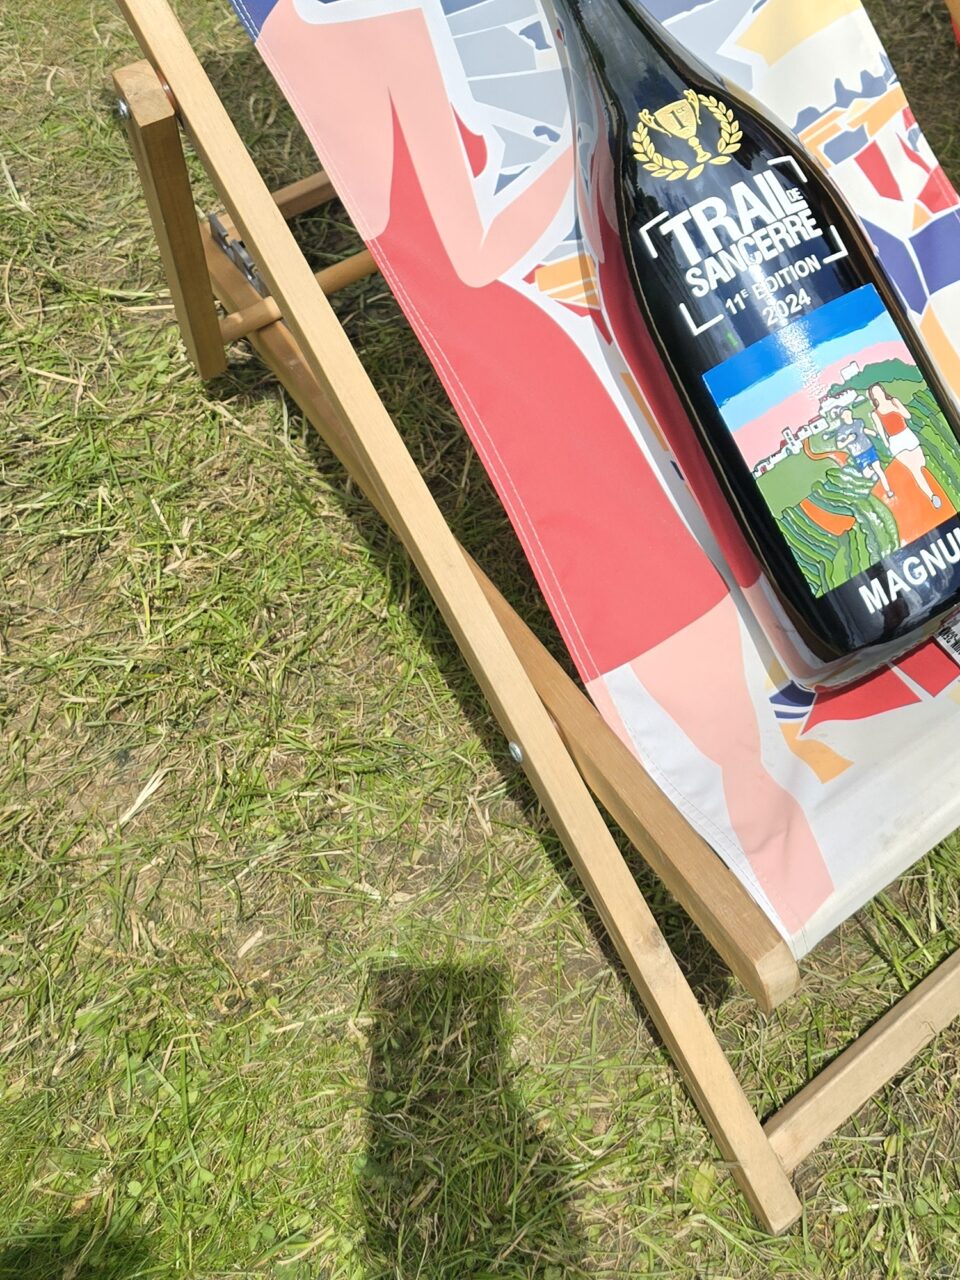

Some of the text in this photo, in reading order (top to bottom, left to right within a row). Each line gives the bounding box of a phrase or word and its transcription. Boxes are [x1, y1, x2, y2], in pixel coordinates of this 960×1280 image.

[660, 171, 808, 266] TRAIL DE
[684, 208, 823, 300] SANCERRE
[751, 254, 822, 300] EDITION
[762, 287, 812, 326] 2024
